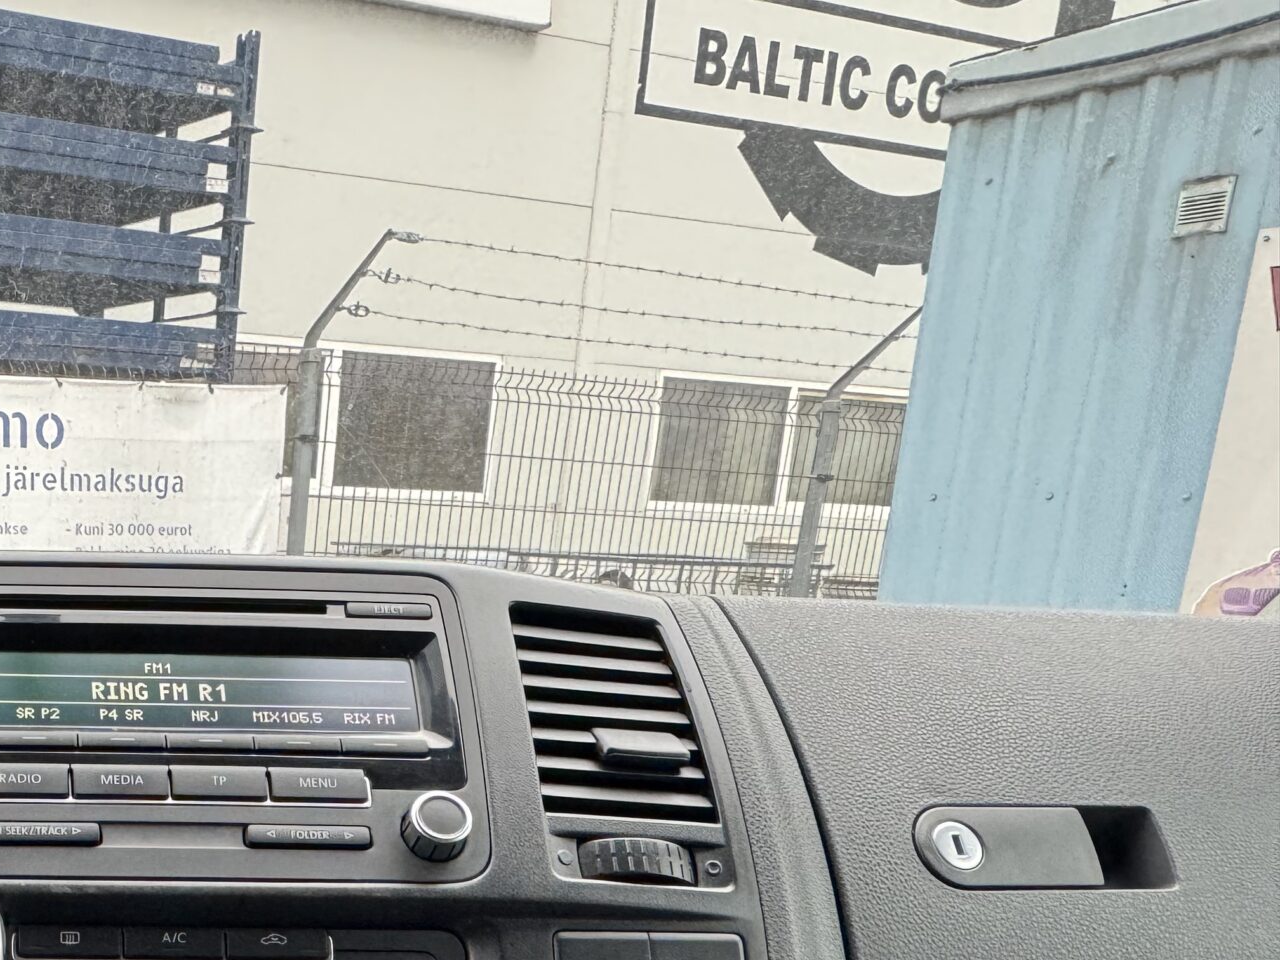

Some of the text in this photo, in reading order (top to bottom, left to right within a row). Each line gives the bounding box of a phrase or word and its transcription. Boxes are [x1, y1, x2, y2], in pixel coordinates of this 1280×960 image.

[694, 27, 871, 111] BALTIC
[3, 464, 185, 501] järelmaksuga
[75, 523, 104, 536] Kuni
[108, 523, 124, 536] 30
[128, 523, 155, 536] 000
[158, 523, 193, 537] eurot
[143, 662, 171, 674] FM1
[91, 681, 227, 702] RING FM R1
[15, 706, 61, 720] SR P2
[99, 708, 144, 721] P4 SR
[190, 709, 219, 723] NRJ
[252, 711, 323, 725] MIX105.5
[343, 712, 396, 726] RIX FM
[0, 772, 42, 785] RADIO
[100, 773, 145, 786] MEDIA
[211, 774, 227, 787] TP
[299, 776, 338, 789] MENU
[161, 931, 187, 945] A/C
